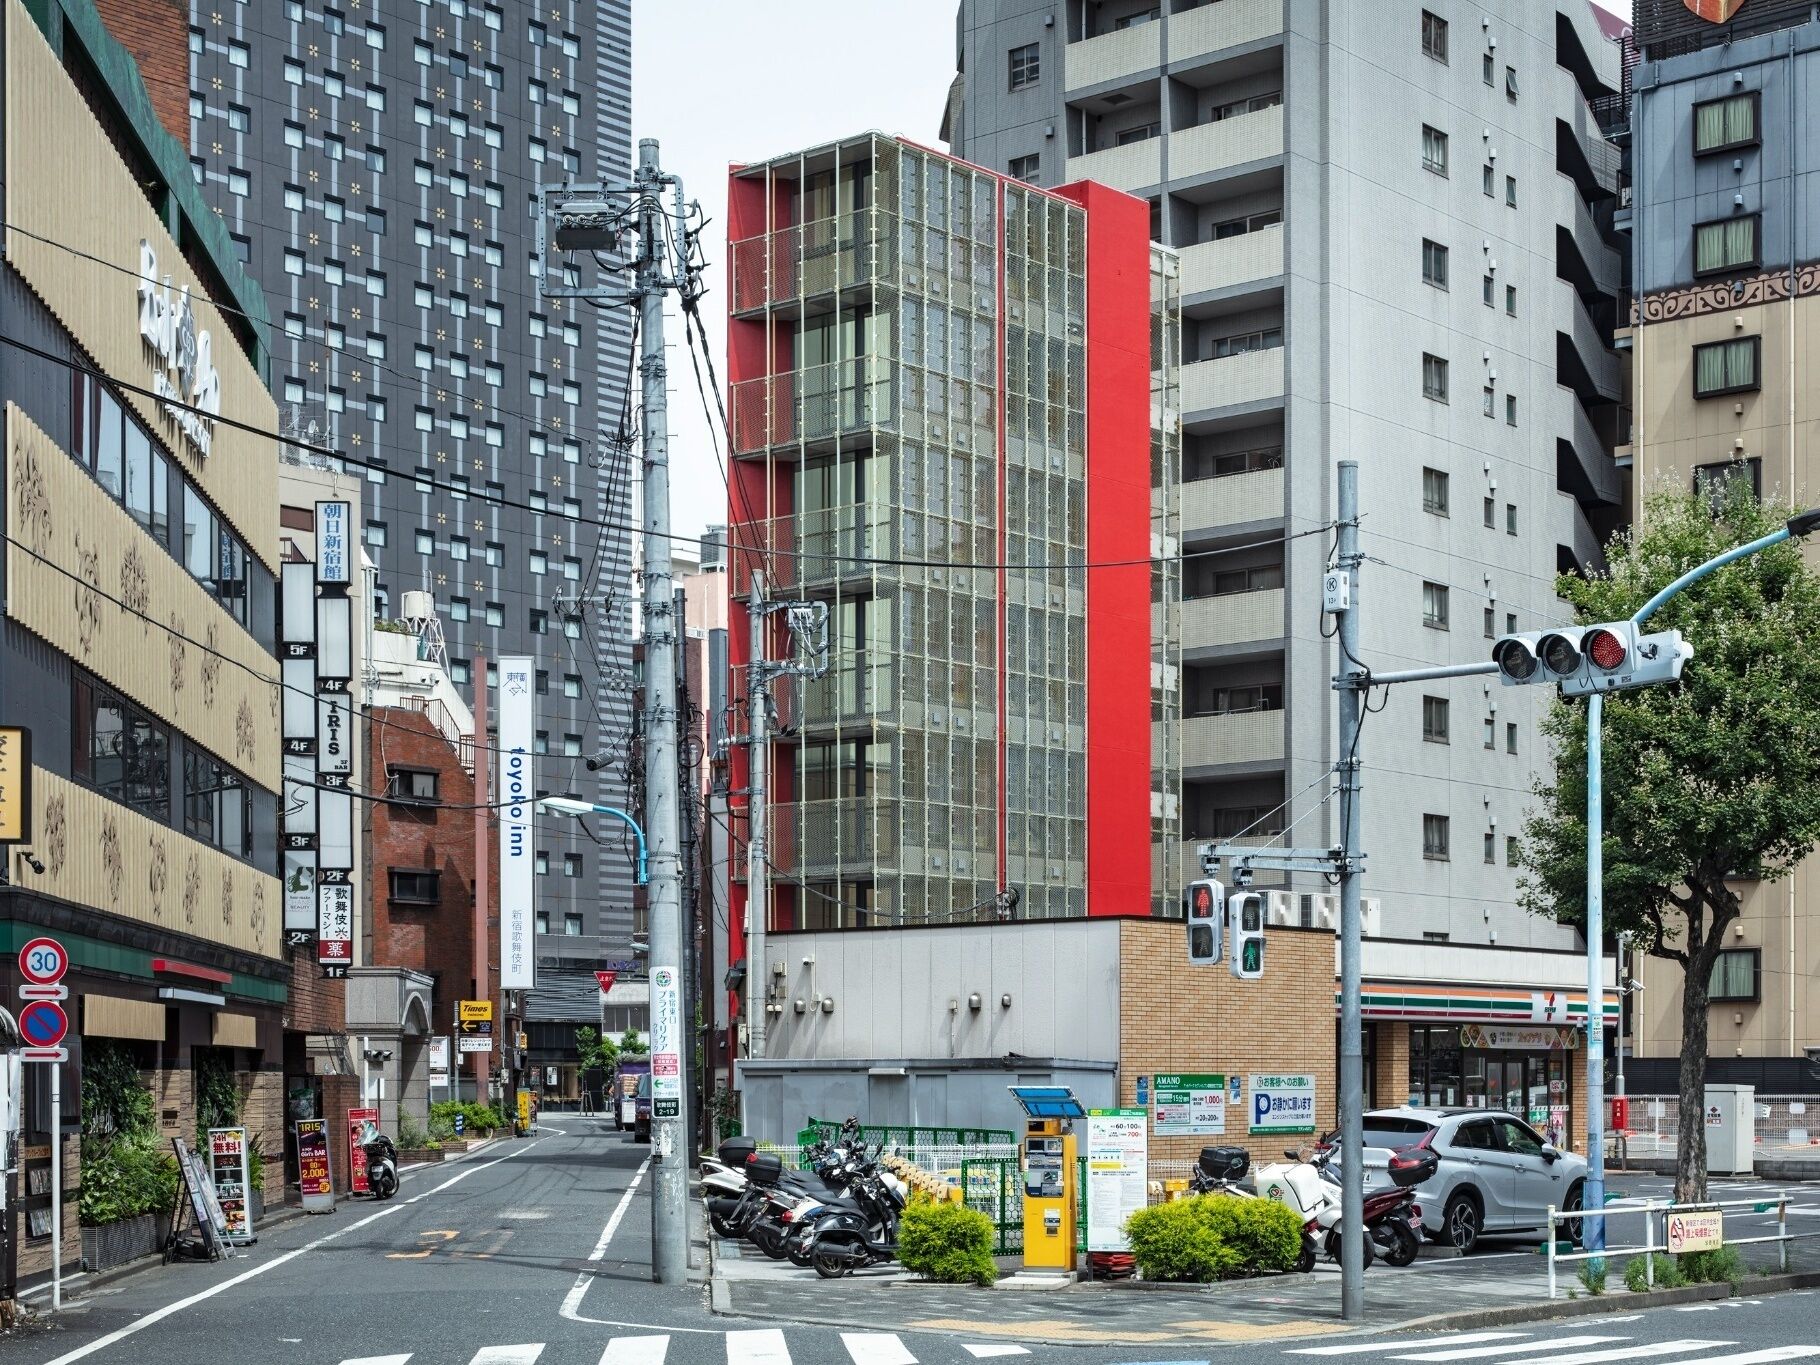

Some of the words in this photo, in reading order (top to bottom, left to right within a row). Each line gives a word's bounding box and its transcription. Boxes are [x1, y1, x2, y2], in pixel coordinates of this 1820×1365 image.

[324, 504, 342, 579] 朝日新宿館
[290, 645, 307, 655] 5F
[325, 680, 342, 690] 4F
[327, 700, 341, 755] IRIS
[291, 740, 308, 751] 4F
[326, 775, 343, 786] 3F
[507, 747, 526, 818] toyoko
[291, 836, 310, 846] 3F
[510, 826, 526, 857] inn
[326, 871, 344, 882] 2F
[323, 887, 331, 939] ファーマシー
[292, 932, 310, 943] 2F
[511, 909, 523, 975] 新宿歌舞伎町
[327, 942, 344, 957] 薬
[31, 952, 57, 972] 30
[326, 967, 344, 978] 1F
[463, 1004, 488, 1012] Times
[669, 991, 677, 1024] 新宿東口
[658, 991, 668, 1052] プライマリケア
[1156, 1076, 1181, 1084] AMANO
[1264, 1077, 1309, 1087] お客様へのお願い
[1255, 1094, 1271, 1124] P
[301, 1123, 321, 1132] IRIS
[212, 1134, 227, 1142] 24H
